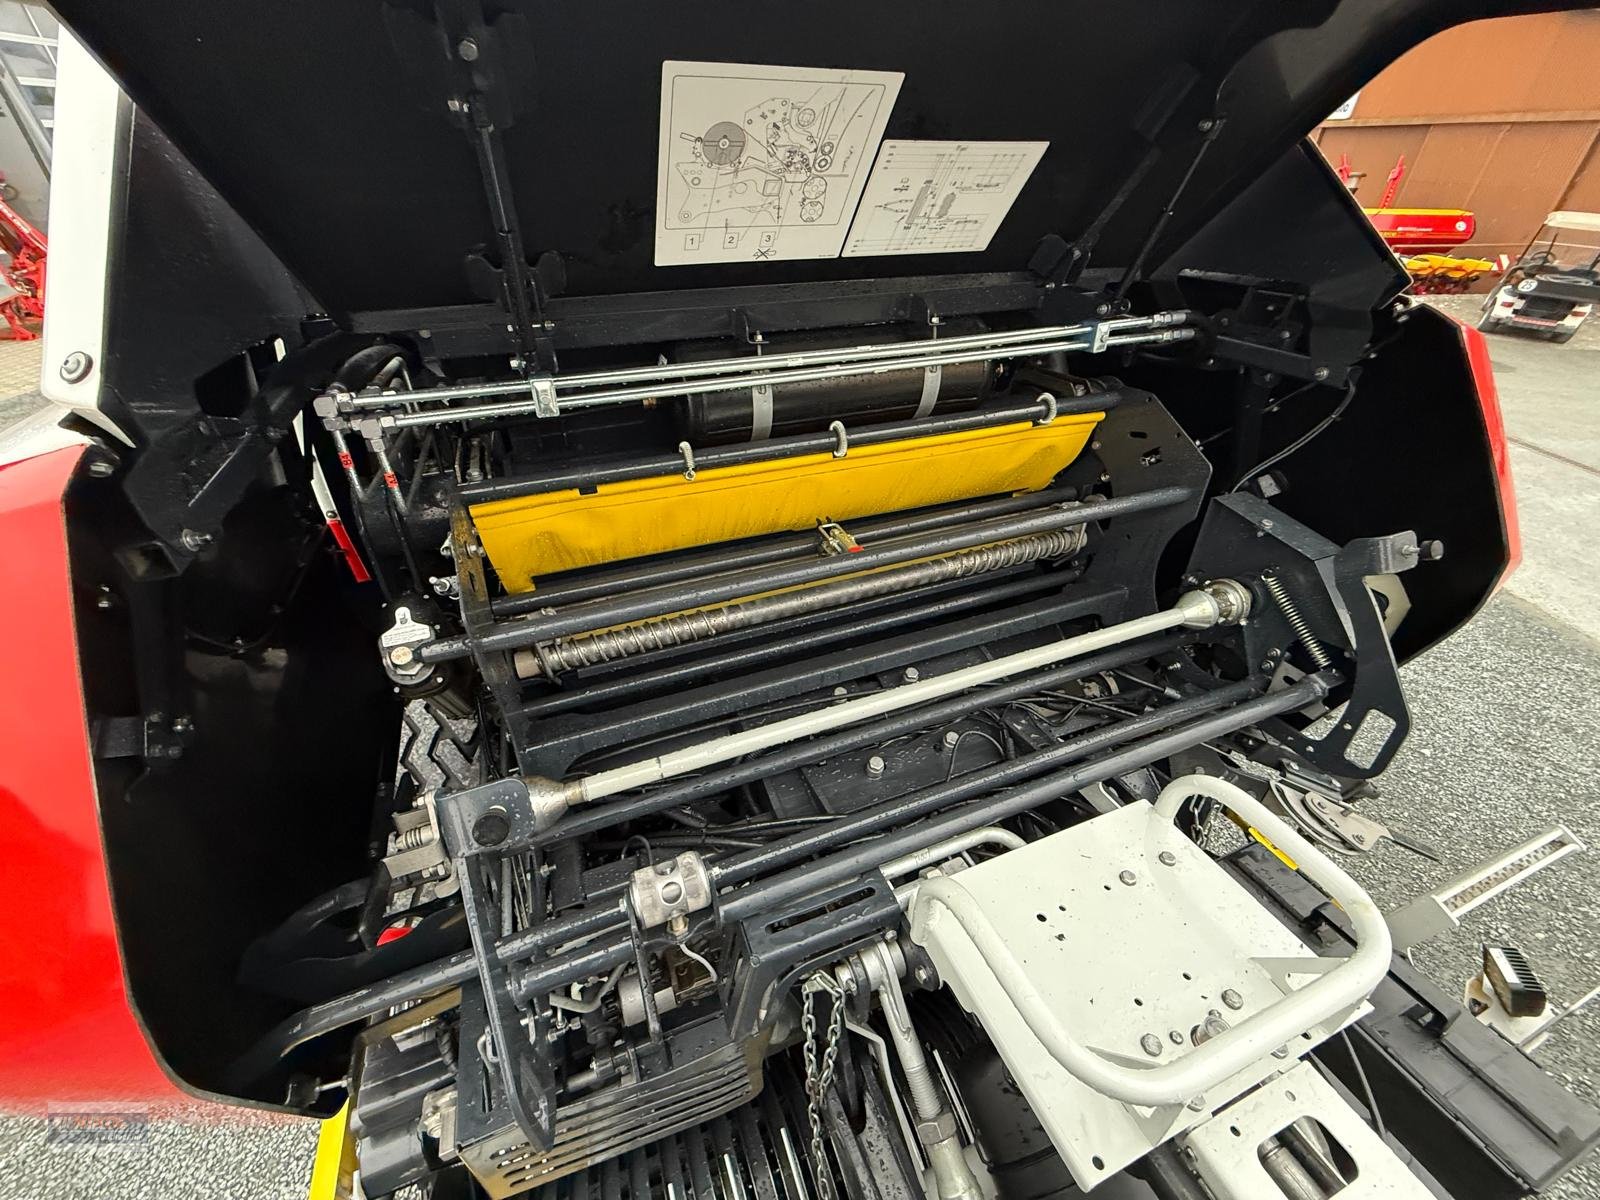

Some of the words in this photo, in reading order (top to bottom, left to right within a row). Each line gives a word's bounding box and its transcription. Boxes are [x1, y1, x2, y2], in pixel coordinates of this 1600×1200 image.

[727, 236, 735, 244] 2
[764, 234, 772, 243] 3
[1521, 280, 1536, 290] 25
